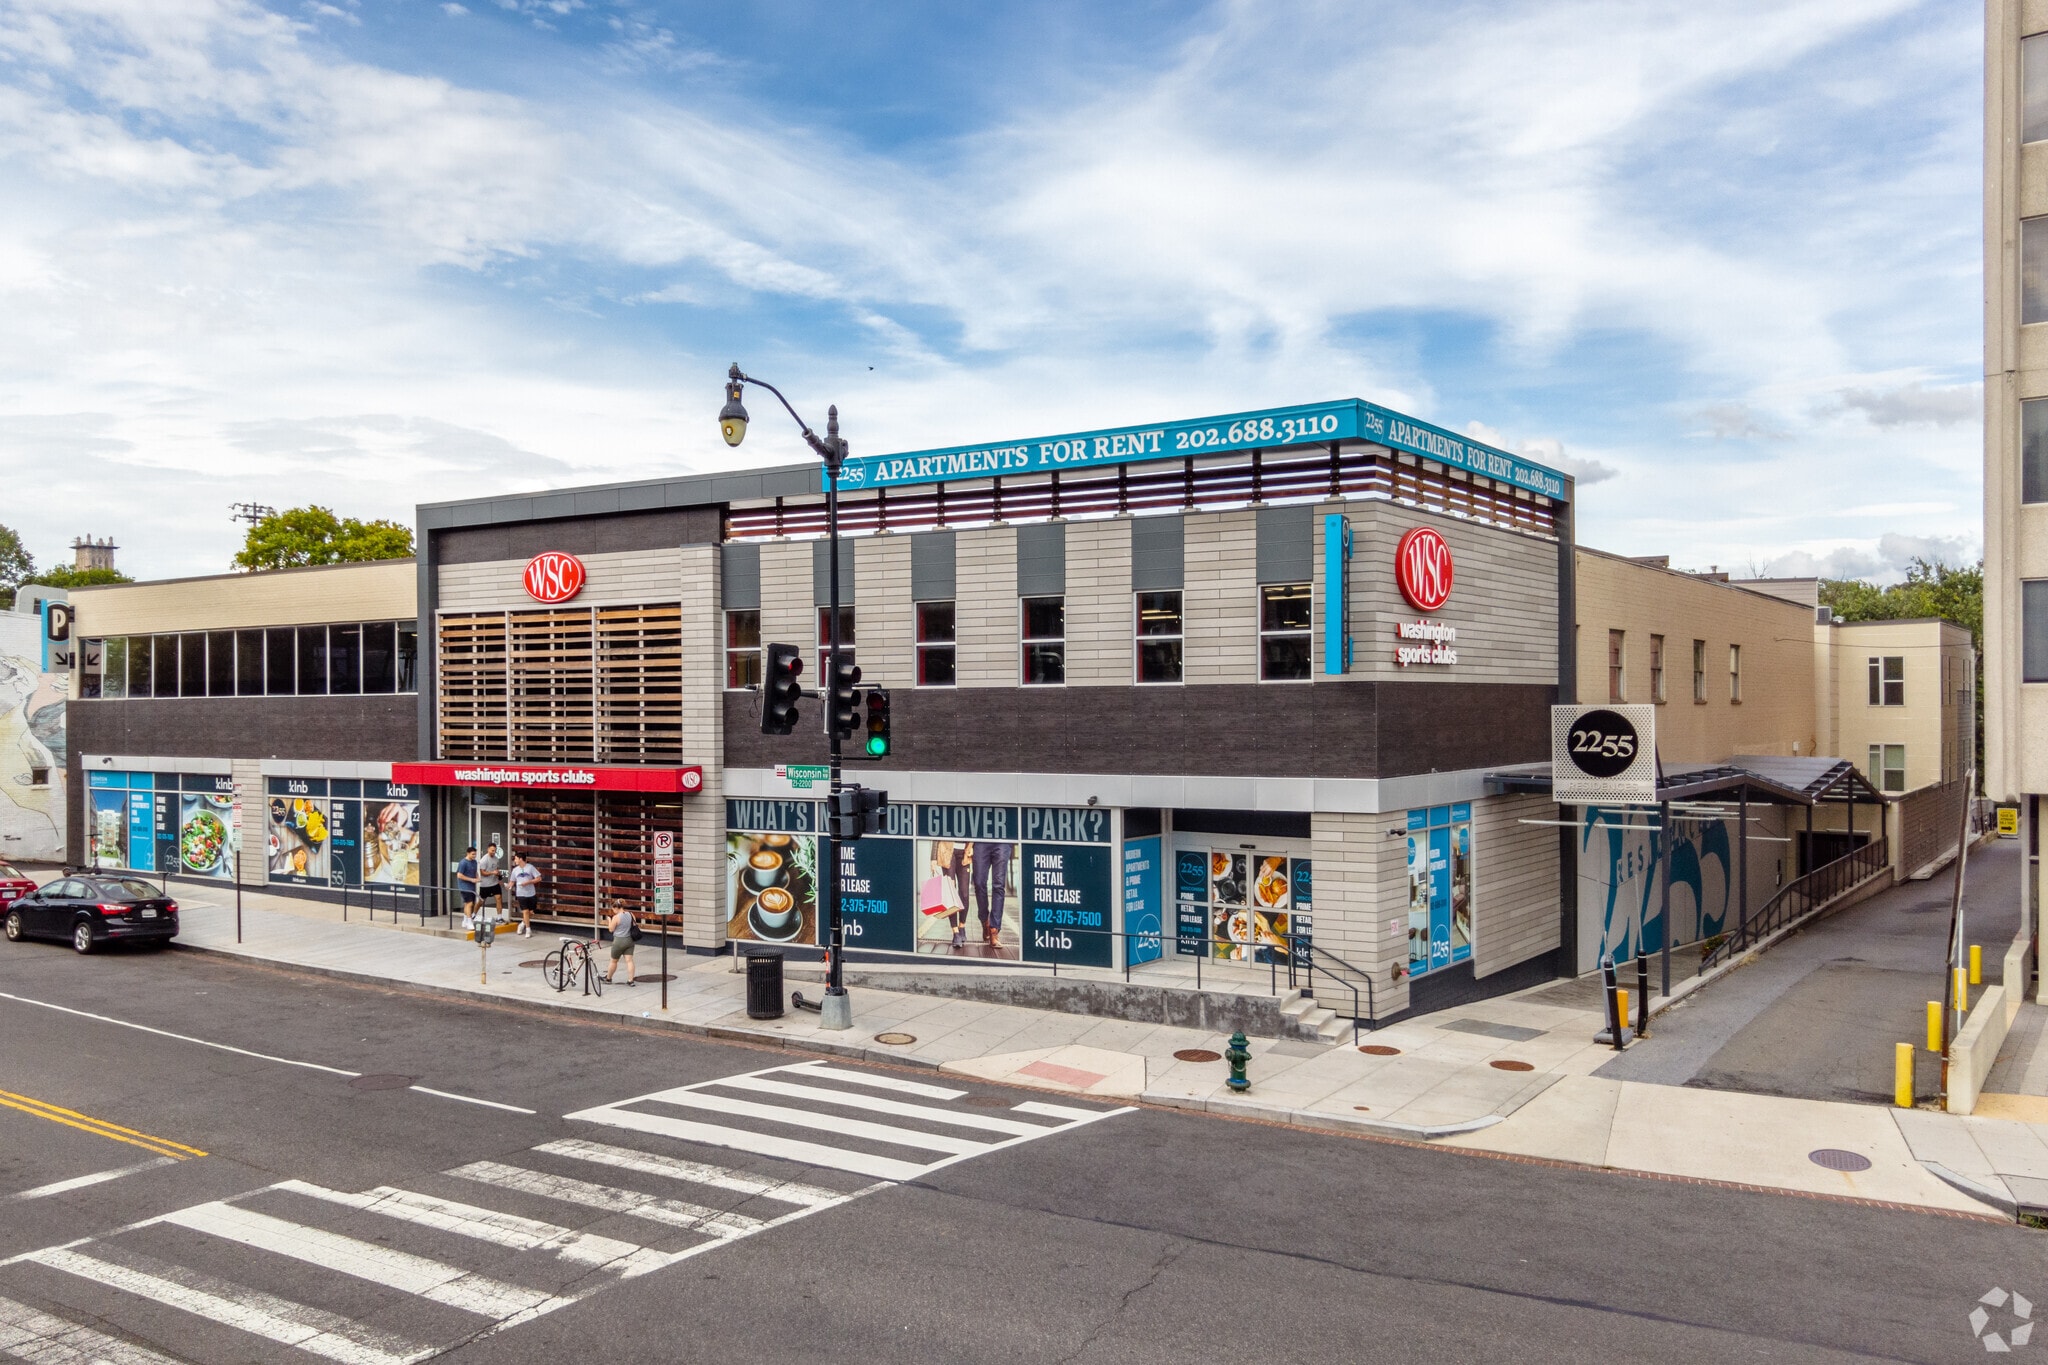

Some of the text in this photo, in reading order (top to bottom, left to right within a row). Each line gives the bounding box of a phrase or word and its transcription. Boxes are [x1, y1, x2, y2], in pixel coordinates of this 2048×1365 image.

[873, 445, 1028, 481] APARTMENTS
[1038, 439, 1089, 464] FOR
[1093, 429, 1164, 458] RENT
[1175, 414, 1339, 449] 202.688.3110
[1365, 412, 1560, 496] 2255 APARTMENTS FOR RENT 202.688.3110
[528, 555, 573, 599] WSC
[1409, 534, 1448, 604] WSC
[52, 608, 66, 636] P
[1398, 620, 1456, 645] washington
[1397, 645, 1457, 667] sports clubs
[1572, 730, 1634, 757] 2255
[454, 768, 596, 786] washington sports clubs
[684, 773, 700, 788] WSC
[788, 768, 822, 778] Wisconsin
[215, 777, 233, 790] klnb
[289, 780, 309, 794] klnb
[387, 784, 409, 797] klnb
[1569, 782, 1639, 792] RESIDENCES
[735, 802, 808, 831] WHAT'S
[927, 805, 1007, 839] GLOVER
[1027, 808, 1103, 841] PARK?
[841, 847, 855, 861] IME
[1034, 854, 1063, 869] PRIME
[1034, 871, 1065, 887] RETAIL
[1181, 863, 1204, 877] 2255
[848, 879, 871, 894] LEASE
[1034, 887, 1081, 905] FOR LEASE
[841, 898, 888, 914] 2-375-7500
[1296, 902, 1312, 911] PRIME
[1034, 908, 1102, 927] 202-375-7500
[841, 919, 863, 937] lnb
[1296, 926, 1306, 934] FOR
[1034, 929, 1073, 950] klnb
[1432, 940, 1449, 959] 2255
